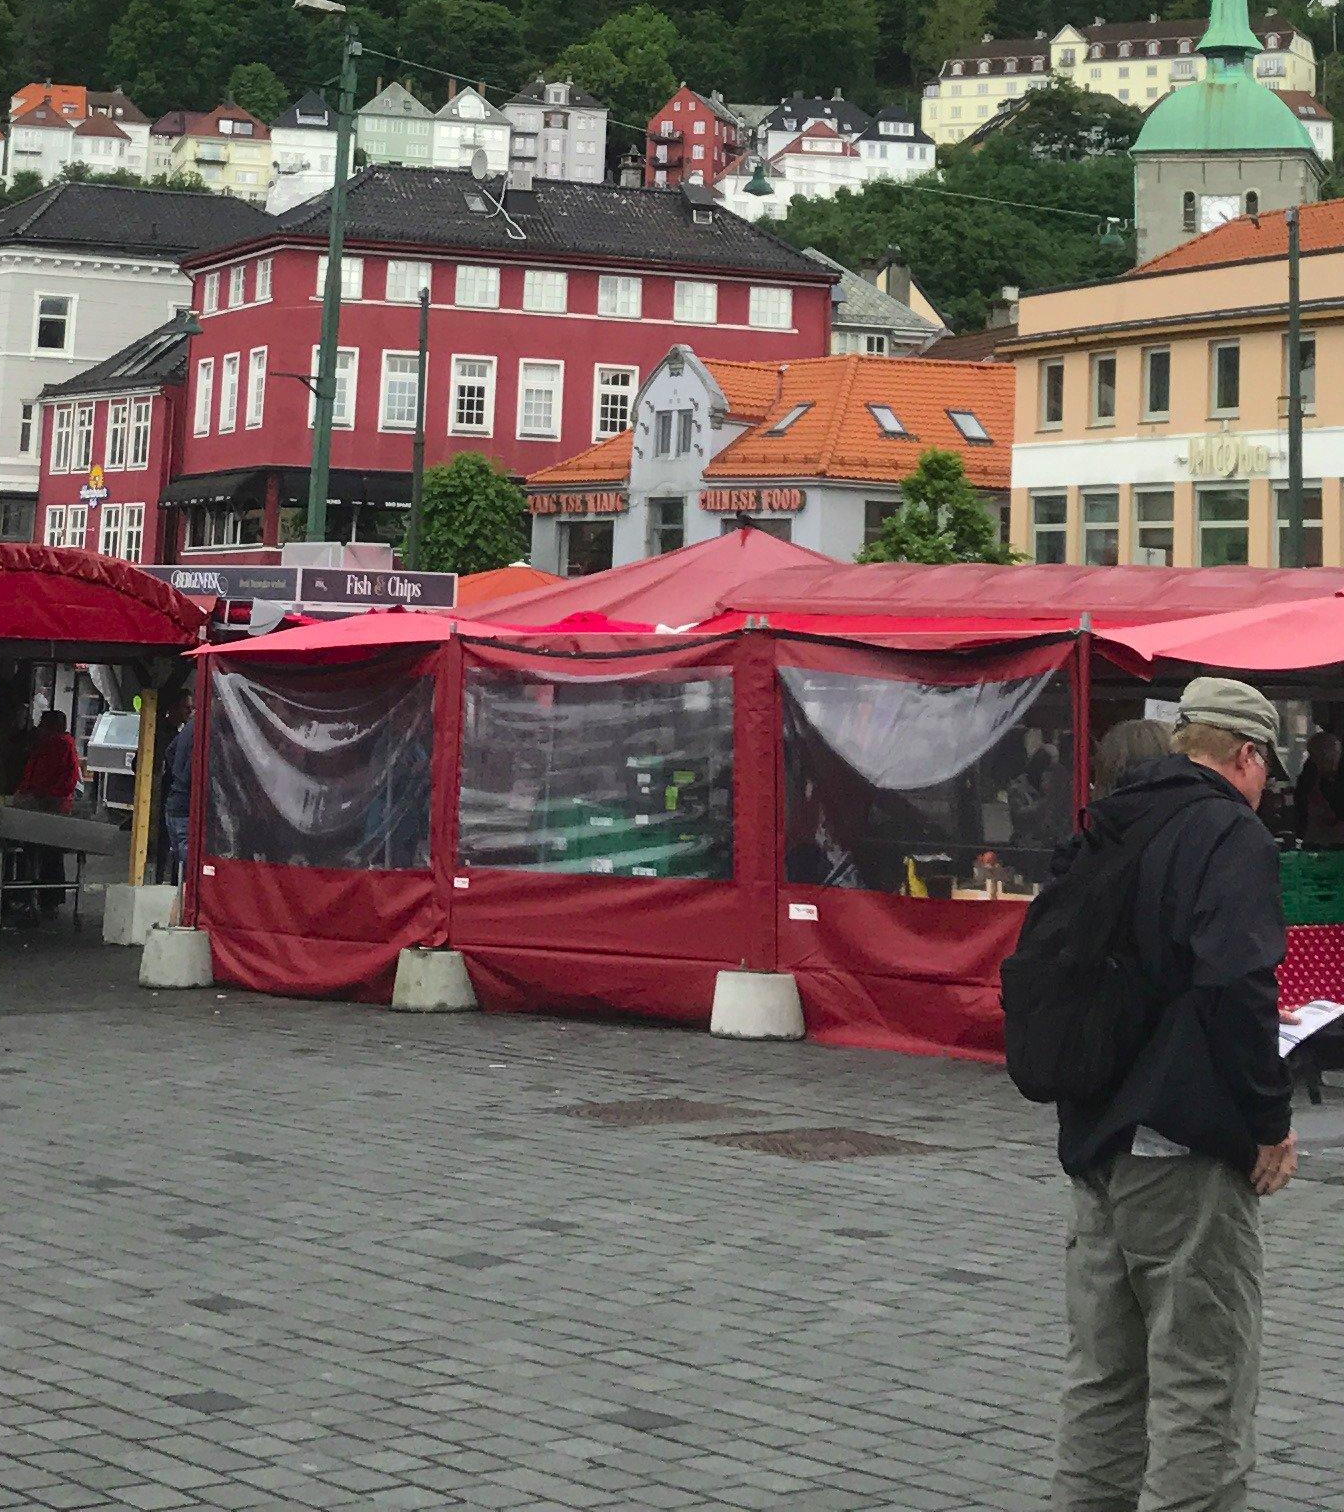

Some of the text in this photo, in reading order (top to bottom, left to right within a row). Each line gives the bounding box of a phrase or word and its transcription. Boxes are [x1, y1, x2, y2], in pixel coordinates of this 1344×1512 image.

[698, 488, 801, 511] CHINESE FOOD
[346, 574, 372, 596] Fish
[374, 575, 385, 595] &
[388, 576, 422, 603] Chips
